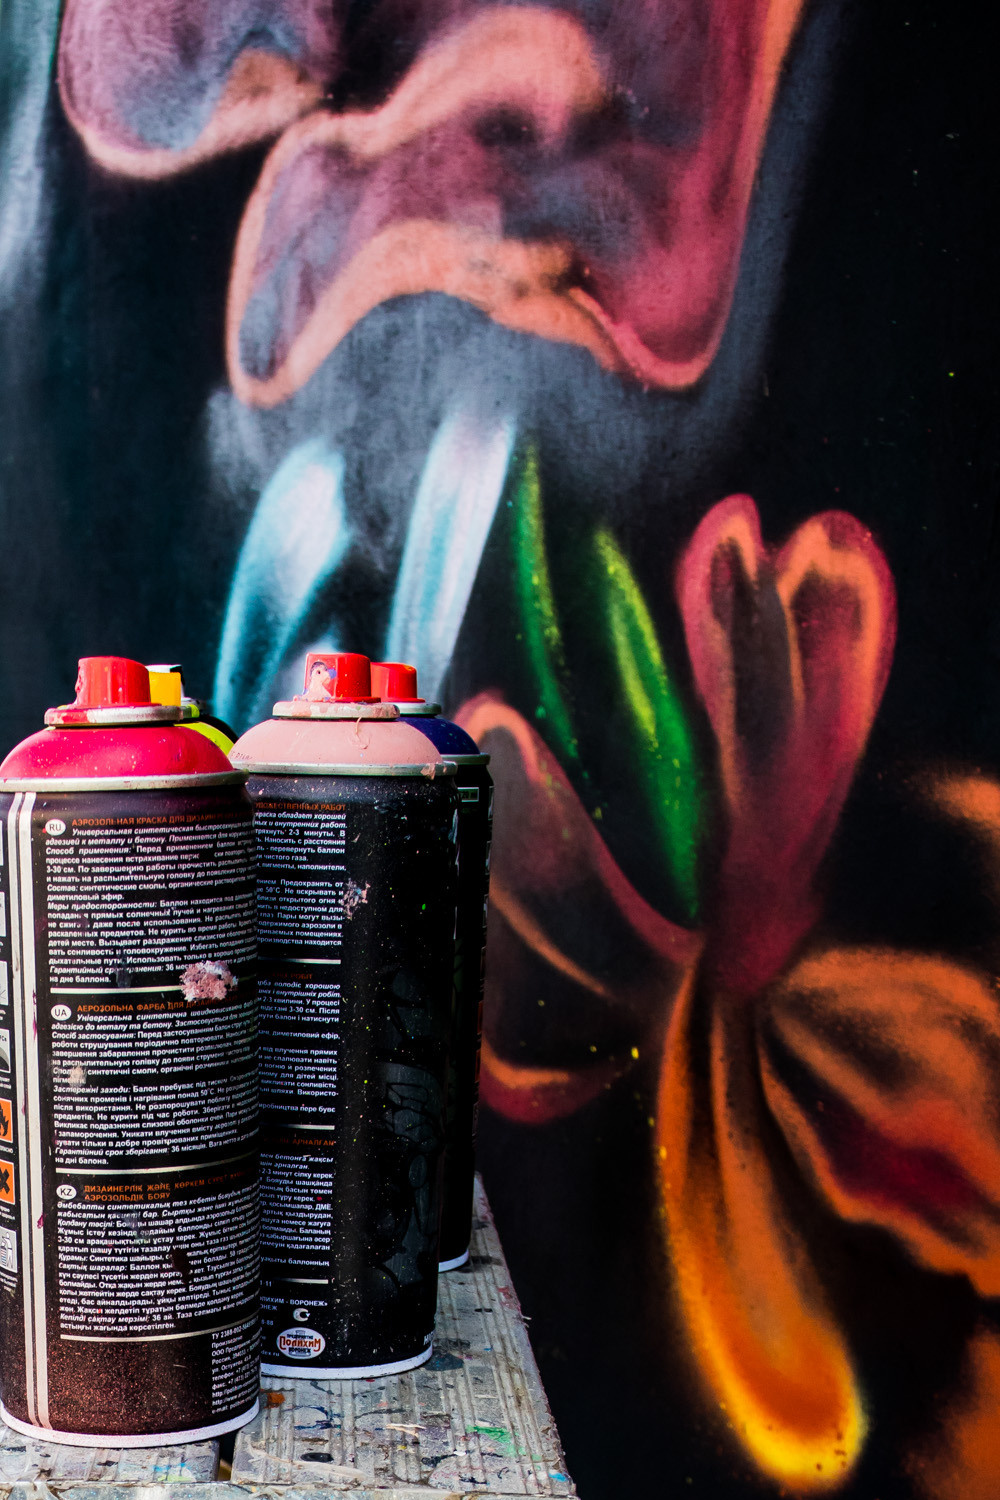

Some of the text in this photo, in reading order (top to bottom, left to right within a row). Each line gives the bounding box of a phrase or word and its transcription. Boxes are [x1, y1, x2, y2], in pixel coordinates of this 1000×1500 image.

[71, 817, 134, 825] АЭРОЗОЛЬНАЯ
[168, 815, 184, 823] ДЛЯ
[314, 813, 346, 821] хорошей
[48, 823, 61, 831] RU
[275, 820, 318, 828] внутренних
[72, 826, 193, 836] Универсальная синтетическая
[304, 830, 335, 838] минуты.
[45, 837, 80, 845] адгезией
[168, 834, 216, 842] Применяется
[264, 836, 296, 844] Наносить
[45, 843, 213, 855] Способ применения: Перед применением
[125, 854, 178, 862] встряхивание
[46, 865, 61, 873] 3-30
[145, 863, 175, 872] работы
[177, 861, 216, 870] прочистить
[93, 872, 164, 882] распылительную
[46, 883, 78, 891] Состав:
[280, 879, 332, 888] Предохранять
[100, 892, 124, 901] эфир.
[279, 896, 316, 904] открытого
[47, 899, 188, 910] Меры предосторожности: Баллон
[280, 905, 327, 913] недоступном
[143, 917, 200, 926] использования.
[277, 913, 319, 922] Пары могут
[301, 922, 335, 930] аэрозоли
[100, 929, 144, 937] предметов.
[160, 927, 186, 935] курить
[98, 938, 140, 946] Вызывает
[142, 936, 192, 945] раздражение
[76, 1004, 133, 1012] АЕРОЗОЛЬНА
[167, 1001, 183, 1009] ДЛЯ
[54, 1008, 66, 1016] UA
[76, 1012, 186, 1022] Універсальна синтетична
[301, 1015, 339, 1023] натиснути
[84, 1022, 95, 1030] до
[142, 1021, 172, 1029] бетону.
[51, 1031, 76, 1039] Спосіб
[137, 1030, 162, 1038] Перед
[321, 1031, 340, 1040] ефір,
[51, 1040, 78, 1048] роботи
[134, 1039, 179, 1048] періодично
[151, 1047, 194, 1056] прочистити
[133, 1094, 175, 1102] нагрівання
[53, 1120, 140, 1130] Викликає подразнення
[64, 1156, 76, 1164] дні
[78, 1156, 108, 1164] балона.
[60, 1188, 72, 1196] KZ
[147, 1192, 170, 1200] БОЯУ
